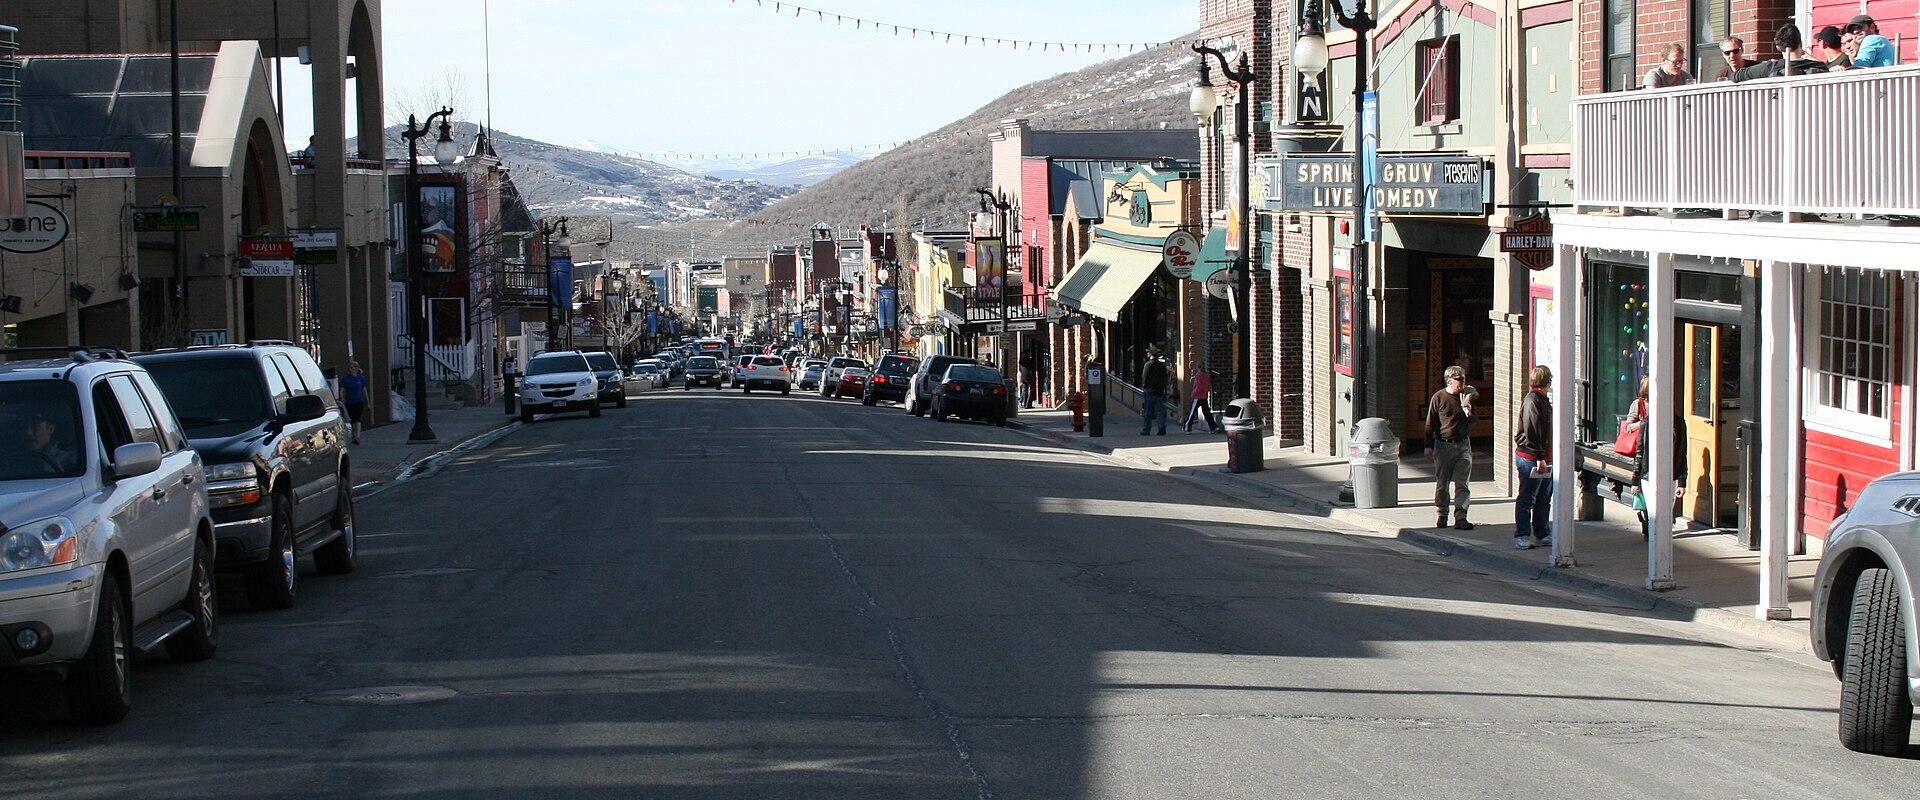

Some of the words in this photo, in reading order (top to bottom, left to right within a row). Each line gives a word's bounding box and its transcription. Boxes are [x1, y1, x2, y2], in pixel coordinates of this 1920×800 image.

[1298, 162, 1355, 183] SPRIN
[1383, 162, 1433, 183] GRUV
[1312, 187, 1353, 207] LIVE
[1376, 188, 1438, 208] OMEDY
[191, 332, 226, 345] ATM
